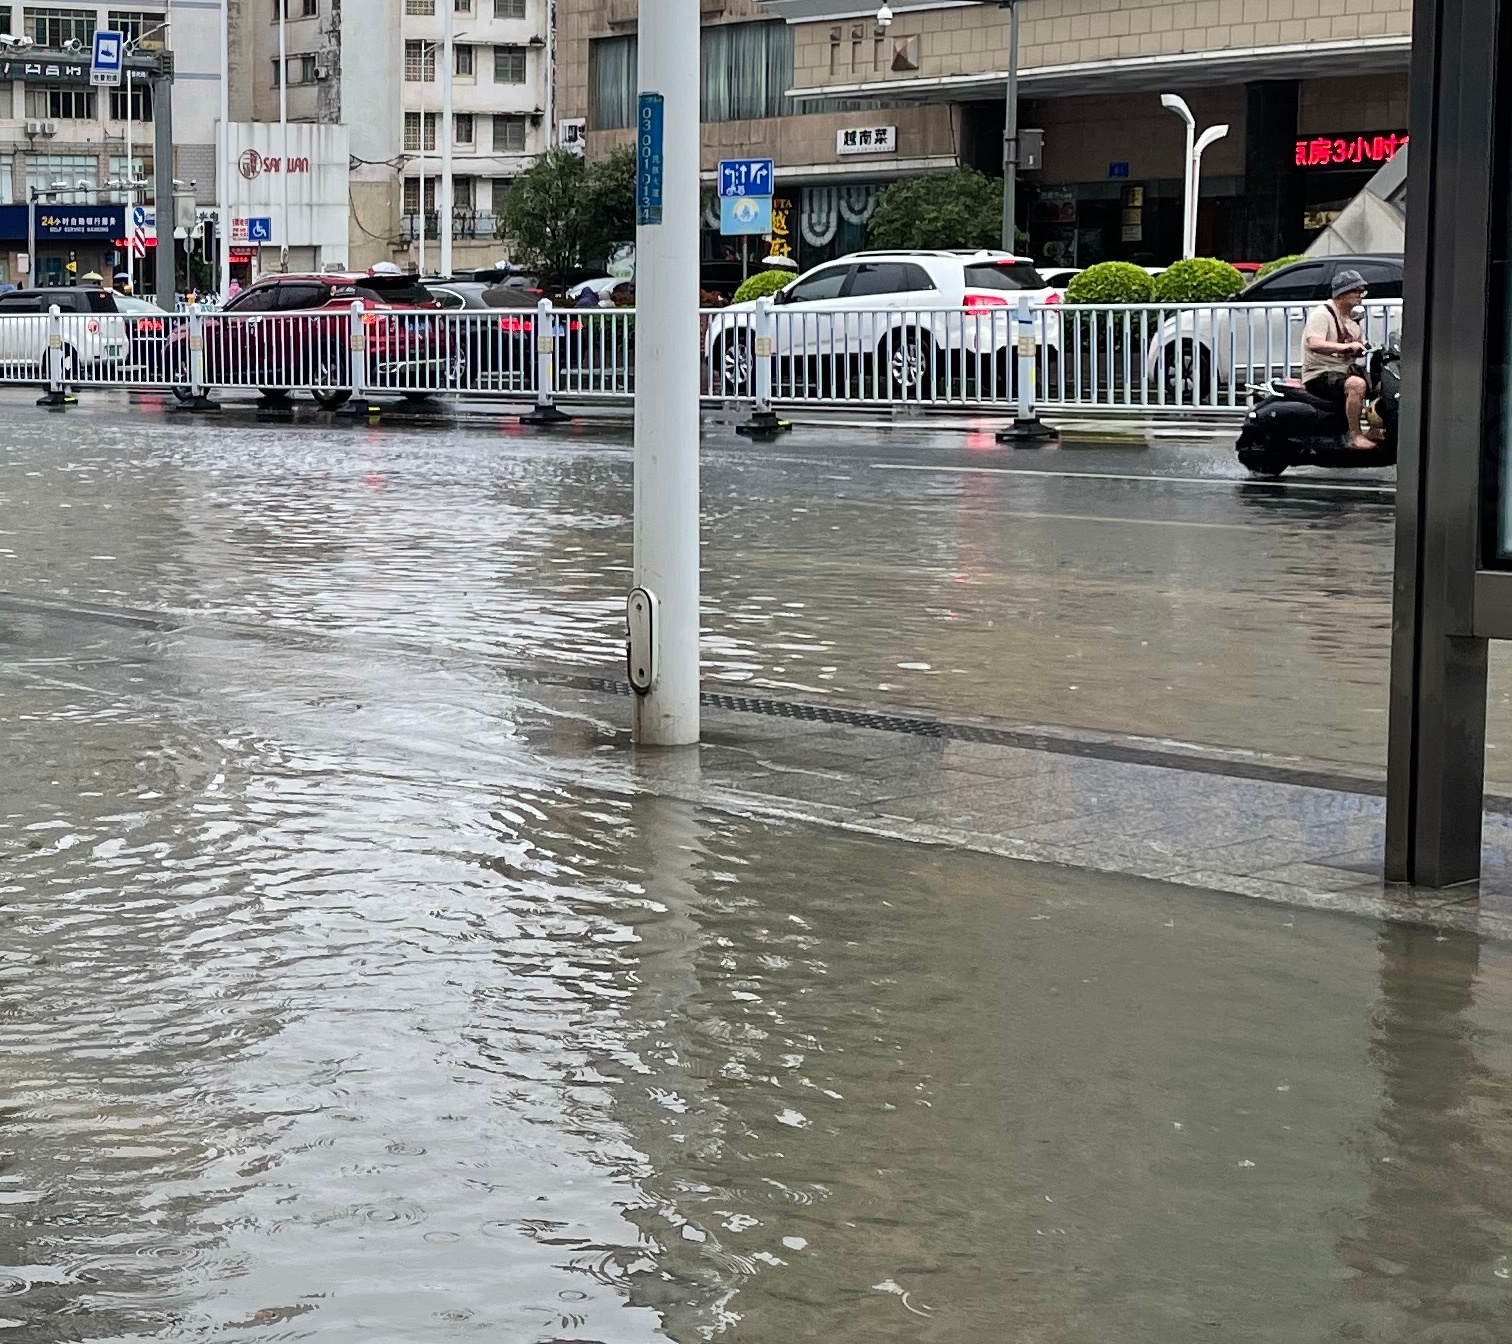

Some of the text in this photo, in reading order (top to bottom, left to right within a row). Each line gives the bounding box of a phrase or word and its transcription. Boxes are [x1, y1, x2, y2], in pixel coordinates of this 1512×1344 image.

[843, 128, 888, 146] 越南菜
[41, 215, 116, 227] 24小时自助银行服务
